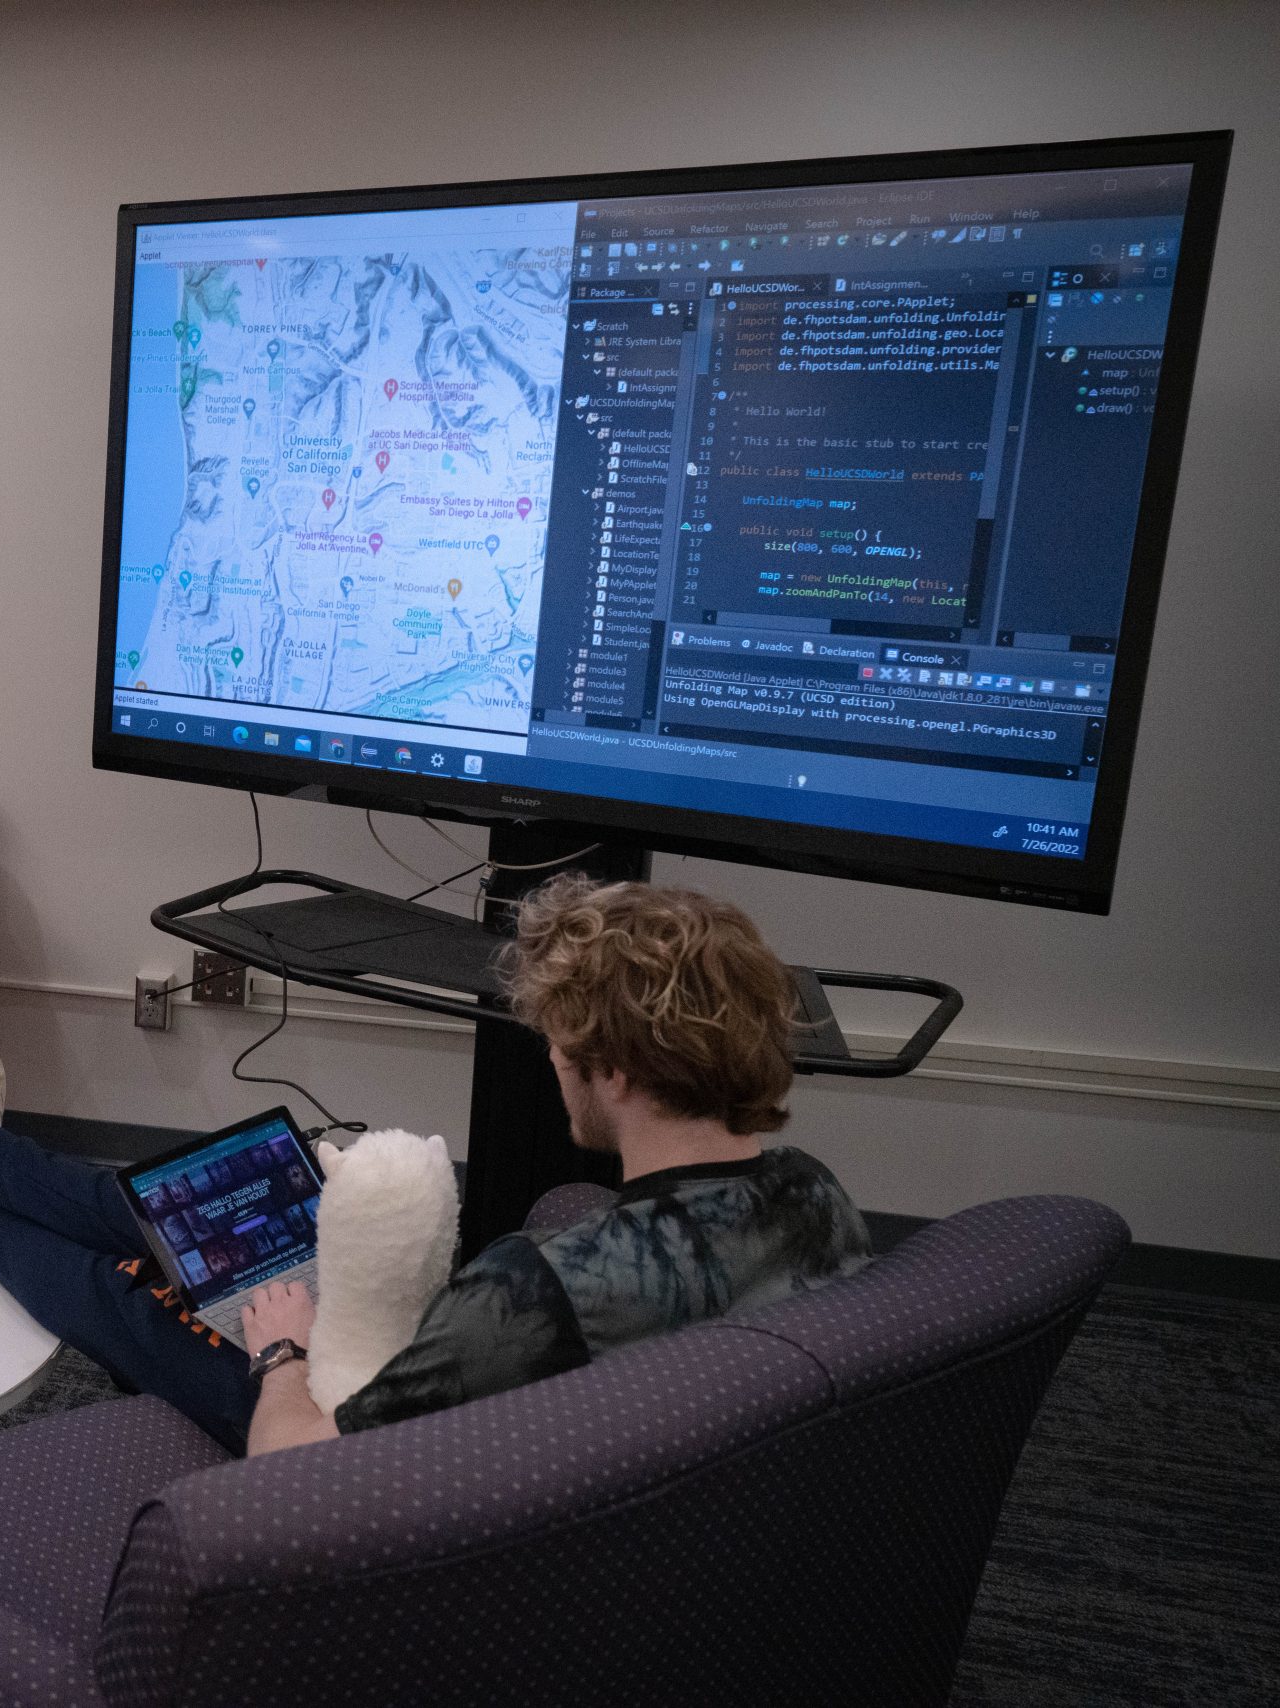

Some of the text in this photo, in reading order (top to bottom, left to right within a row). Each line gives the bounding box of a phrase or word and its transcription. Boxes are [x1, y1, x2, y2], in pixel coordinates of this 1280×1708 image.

[581, 209, 1040, 239] File Edit Source Refactor Navigate Search Project Run Window Help
[140, 252, 162, 261] Applet
[726, 284, 805, 294] HelloUCSDWor...
[851, 280, 929, 291] IntAssignmen...
[590, 288, 626, 299] Package
[784, 296, 956, 313] processing.core.PApplet;
[242, 324, 308, 334] TORREY PINES
[597, 322, 629, 331] Scratch
[148, 329, 172, 337] Beach
[626, 337, 657, 348] System
[1088, 350, 1164, 360] HelloUCSDW
[242, 366, 301, 377] North Campus
[618, 367, 653, 378] (default
[1102, 369, 1129, 380] map
[400, 380, 479, 392] Scripps Memorial
[1099, 386, 1140, 398] setup()
[399, 391, 437, 402] Hospital
[205, 405, 239, 414] Marshall
[746, 406, 827, 418] Hello World!
[1096, 403, 1133, 415] draw()
[206, 416, 236, 426] College
[369, 430, 439, 440] Jacobs Medical
[612, 429, 647, 439] (default
[290, 435, 343, 449] University
[379, 441, 471, 452] UC San Diego Health
[525, 440, 552, 450] North
[744, 436, 960, 450] This is the basic stub to start
[282, 449, 348, 461] of California
[241, 457, 270, 466] Revelle
[239, 466, 270, 477] College
[287, 462, 341, 476] San Diego
[720, 466, 963, 481] public class HelloUCSDWorld extends
[606, 489, 636, 499] demos
[400, 494, 515, 509] Embassy Suites by Hilton
[742, 496, 857, 511] UnfoldingMap map;
[428, 508, 514, 520] San Diego La Jolla
[295, 532, 356, 544] Hyatt Regency
[739, 525, 868, 542] public void setup()
[296, 542, 316, 551] Jolla
[419, 538, 485, 550] Westfield UTC
[764, 541, 923, 560] size(800, OPENGL);
[612, 564, 658, 576] MyDisplay
[214, 576, 253, 587] Aquarium
[760, 571, 781, 582] map
[192, 584, 262, 596] Scripps Institution
[394, 583, 445, 594] McDonald's
[318, 600, 361, 611] San Diego
[287, 608, 360, 621] California Temple
[406, 608, 432, 620] Doyle
[392, 618, 443, 632] Community
[407, 630, 427, 640] Park
[283, 640, 327, 650] LA JOLLA
[688, 636, 731, 648] Problems
[754, 641, 793, 653] Javadoc
[176, 644, 230, 657] Dan McKinney
[285, 649, 324, 660] VILLAGE
[590, 651, 628, 662] module1
[820, 646, 875, 659] Declaration
[178, 654, 229, 666] Family YMCA
[452, 650, 517, 665] University City
[902, 652, 945, 665] Console
[484, 664, 515, 675] School
[588, 666, 627, 676] module3
[666, 666, 741, 682] HelloUCSDWorld
[232, 684, 272, 695] HEIGHTS
[587, 680, 625, 690] module4
[400, 696, 432, 707] Canyon
[586, 694, 624, 705] module5
[666, 680, 896, 711] Unfolding Map v0.9.7 (UCSD edition)
[392, 705, 415, 716] Open
[664, 693, 1058, 741] Using OpenGLMapDisplay with processing.opengl.PGraphics3D
[532, 727, 738, 758] HelloUCSDWorld.java UCSDUnfoldingMaps/src
[501, 796, 542, 808] SHARP
[1026, 822, 1079, 838] 10:41 AM
[1021, 838, 1080, 855] 7/26/2022
[196, 1178, 272, 1216] ZEG HALLO TEGEN ALLES
[206, 1207, 226, 1221] WAAR
[227, 1202, 235, 1212] JE
[234, 1197, 249, 1208] VAN
[248, 1187, 270, 1202] HOUDT
